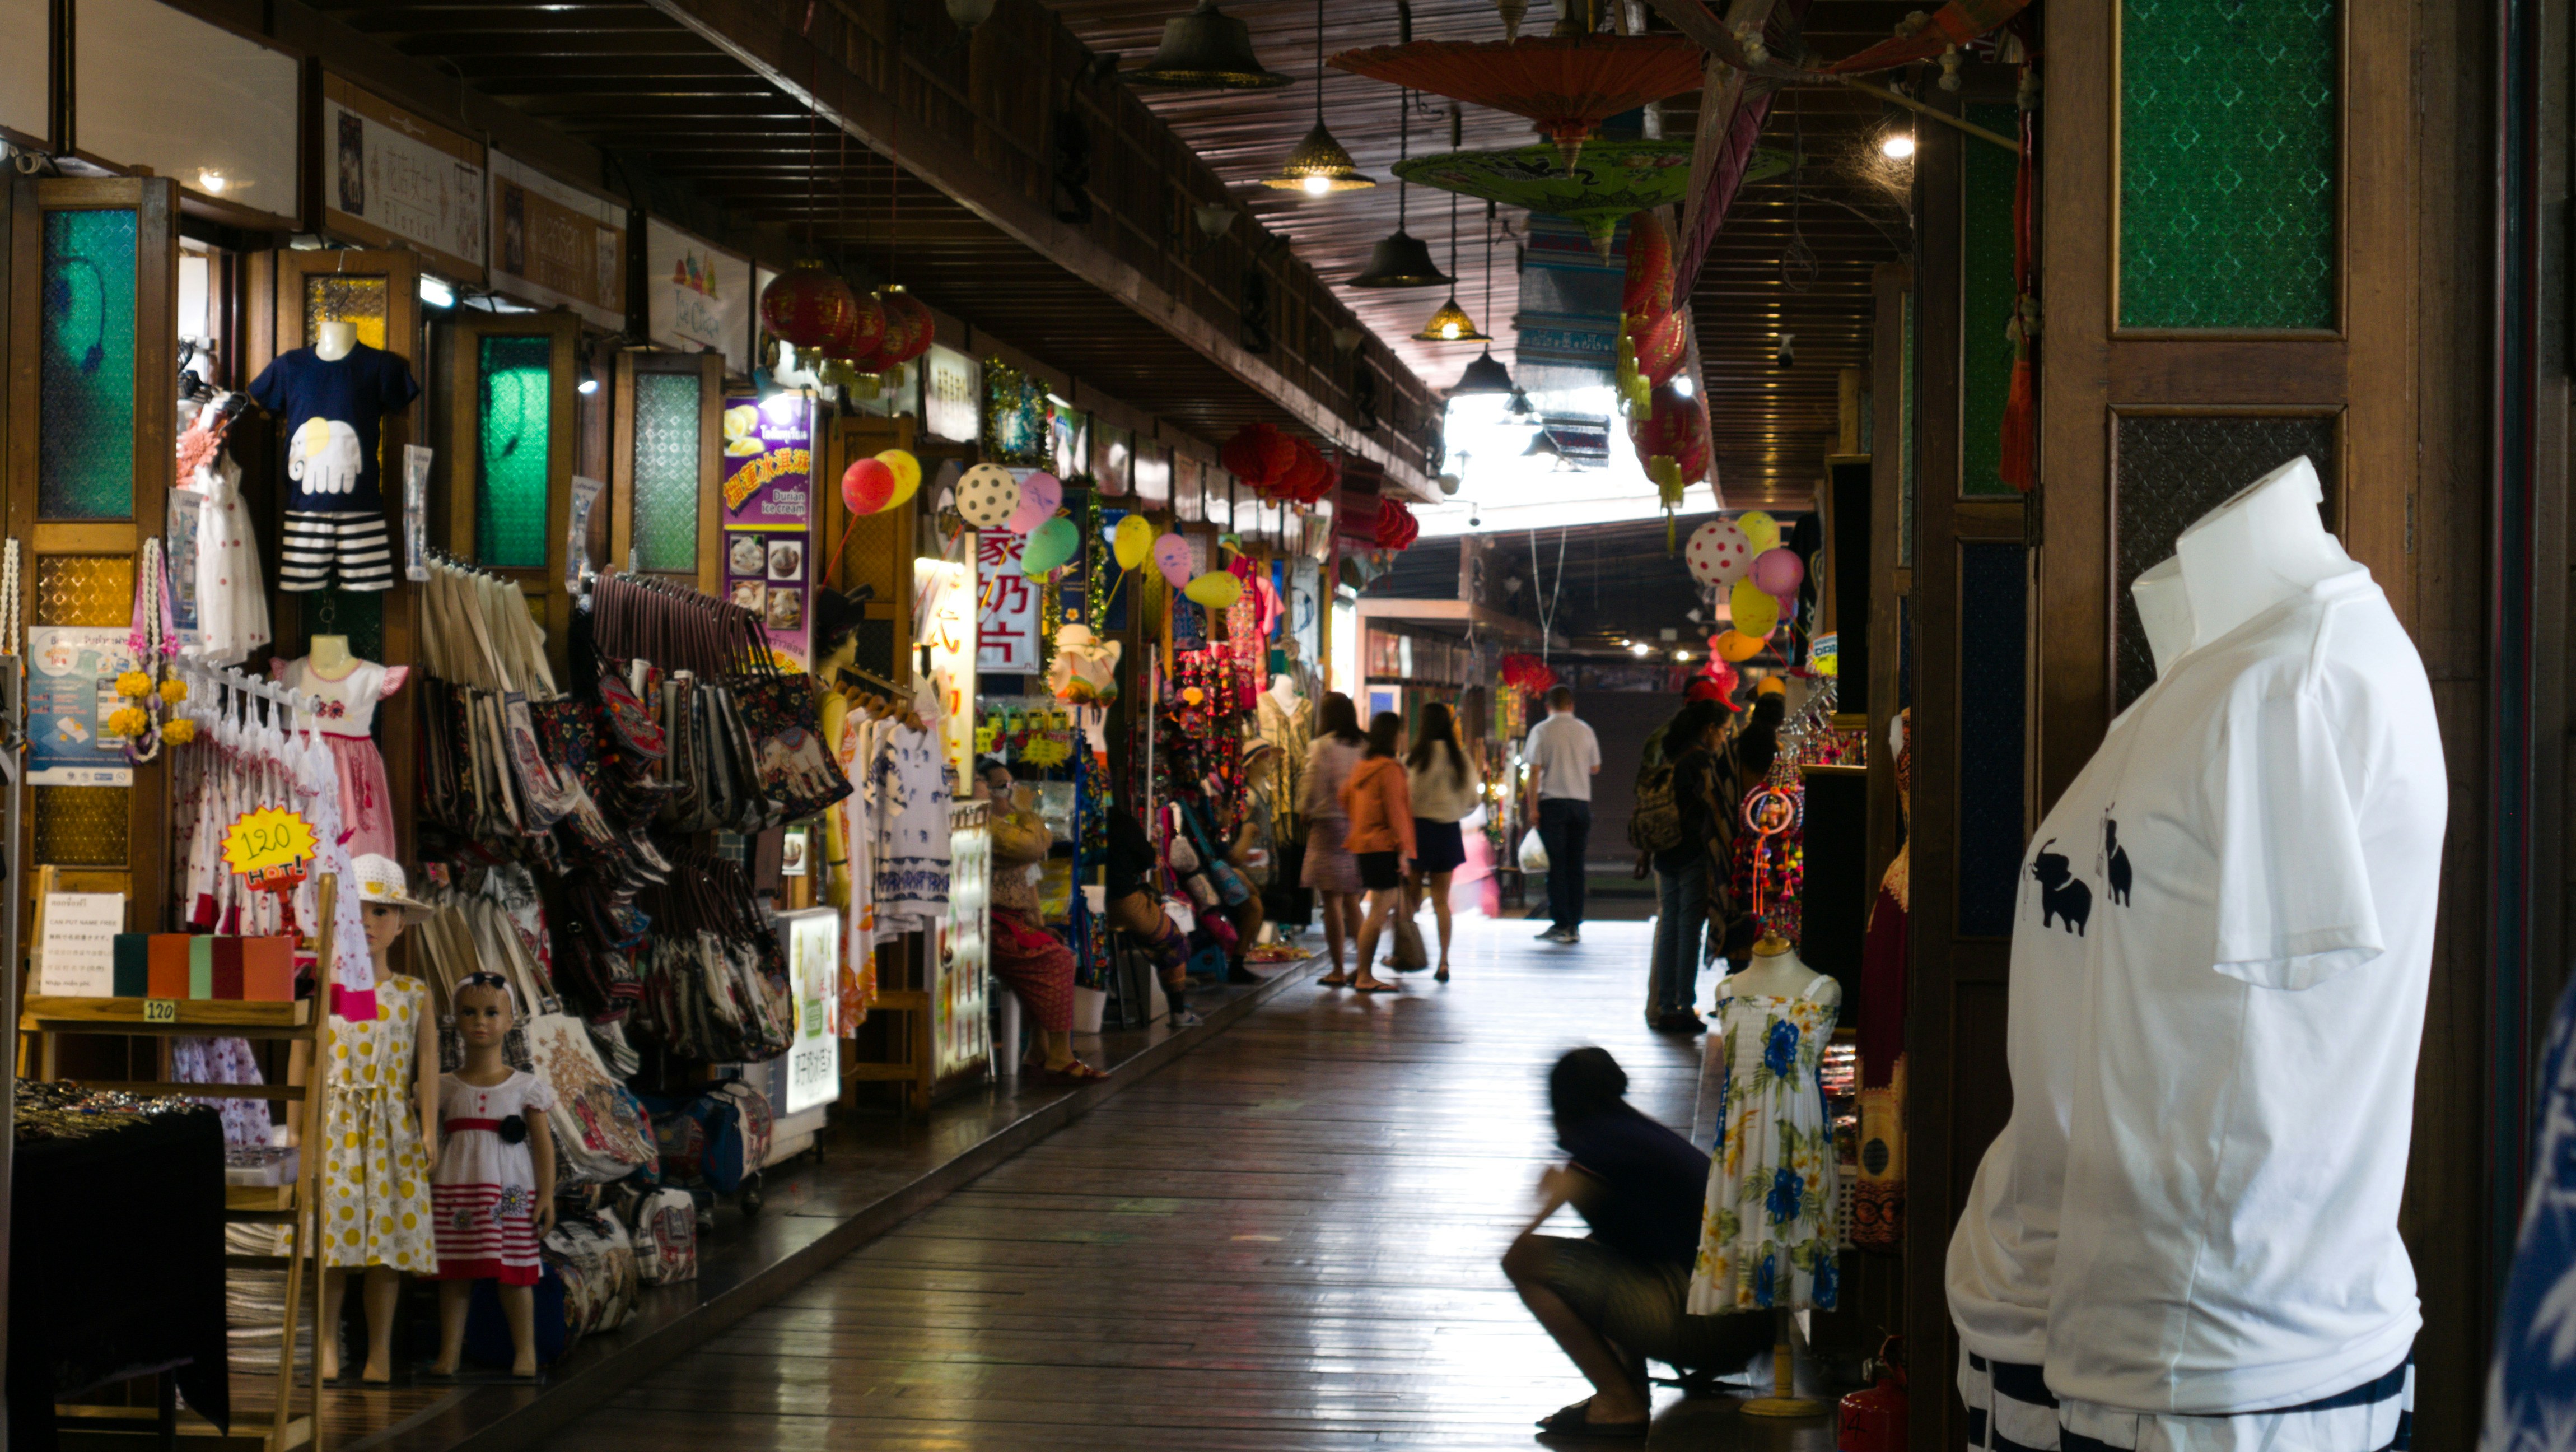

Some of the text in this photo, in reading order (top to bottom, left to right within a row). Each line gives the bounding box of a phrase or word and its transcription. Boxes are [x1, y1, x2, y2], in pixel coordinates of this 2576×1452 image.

[773, 489, 805, 501] Durian
[762, 501, 805, 514] ice cream
[241, 823, 290, 861] 120
[248, 855, 303, 884] HOT!
[148, 1002, 172, 1019] 120
